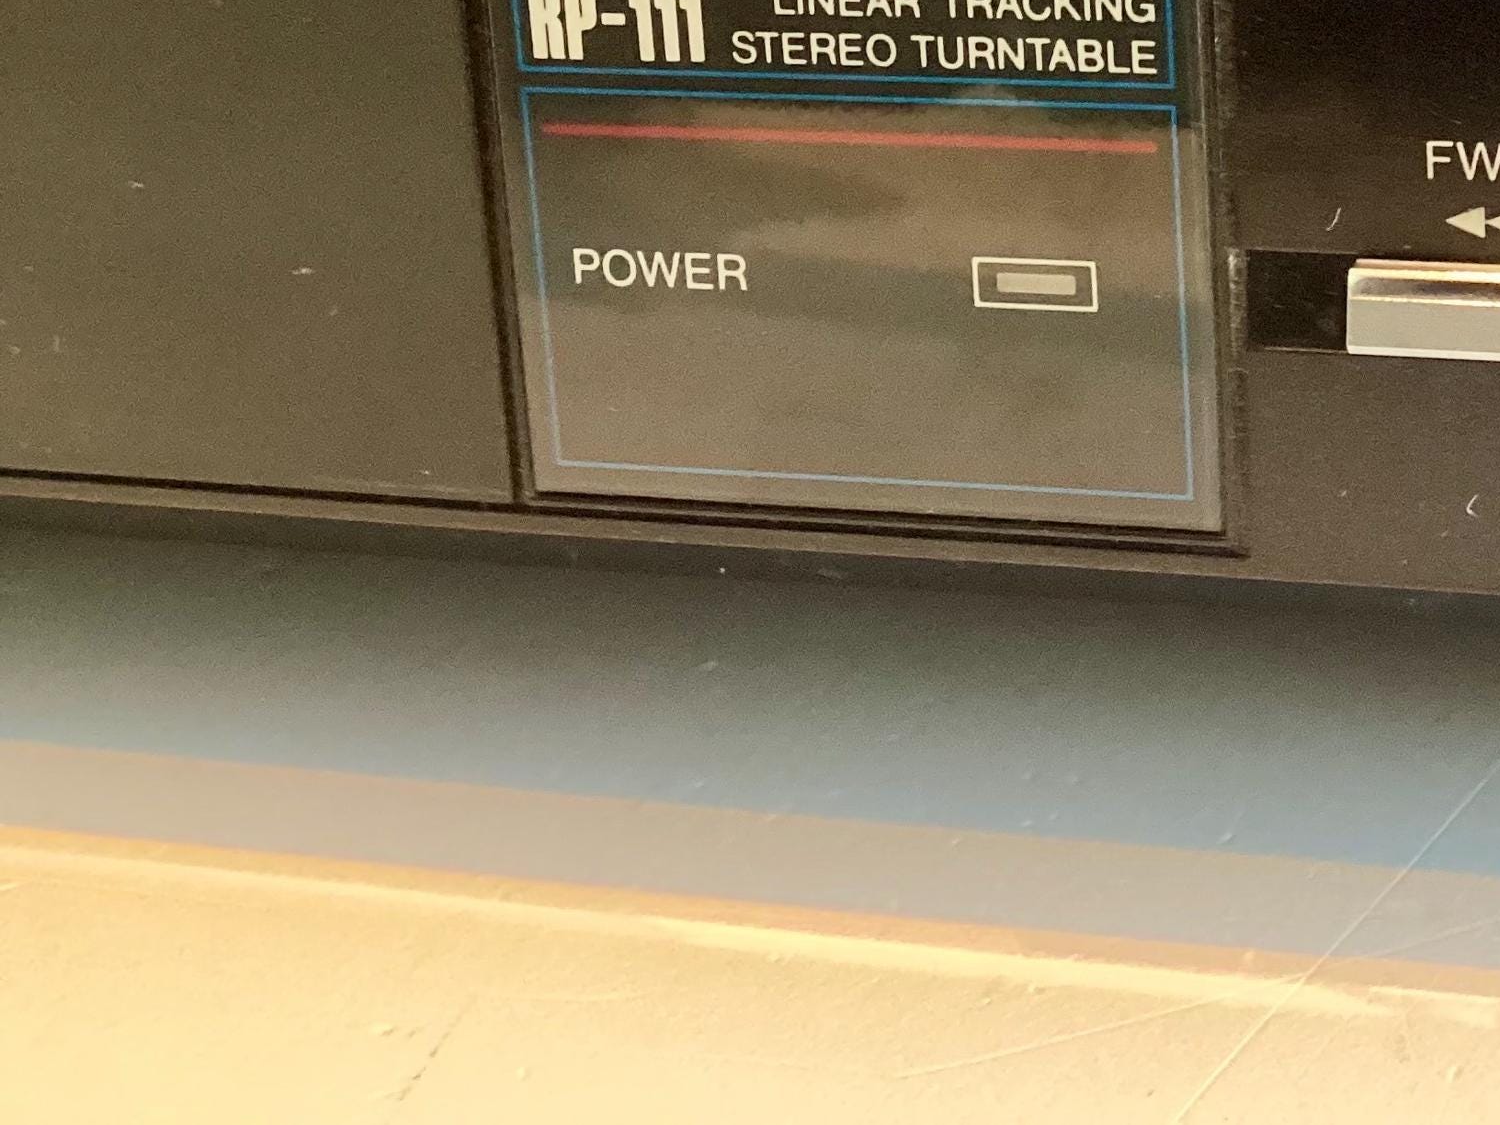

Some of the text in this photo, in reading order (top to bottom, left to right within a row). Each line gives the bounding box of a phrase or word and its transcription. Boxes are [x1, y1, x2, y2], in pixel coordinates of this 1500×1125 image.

[731, 30, 1159, 75] STEREO TURNTABLE
[572, 247, 749, 292] POWER
